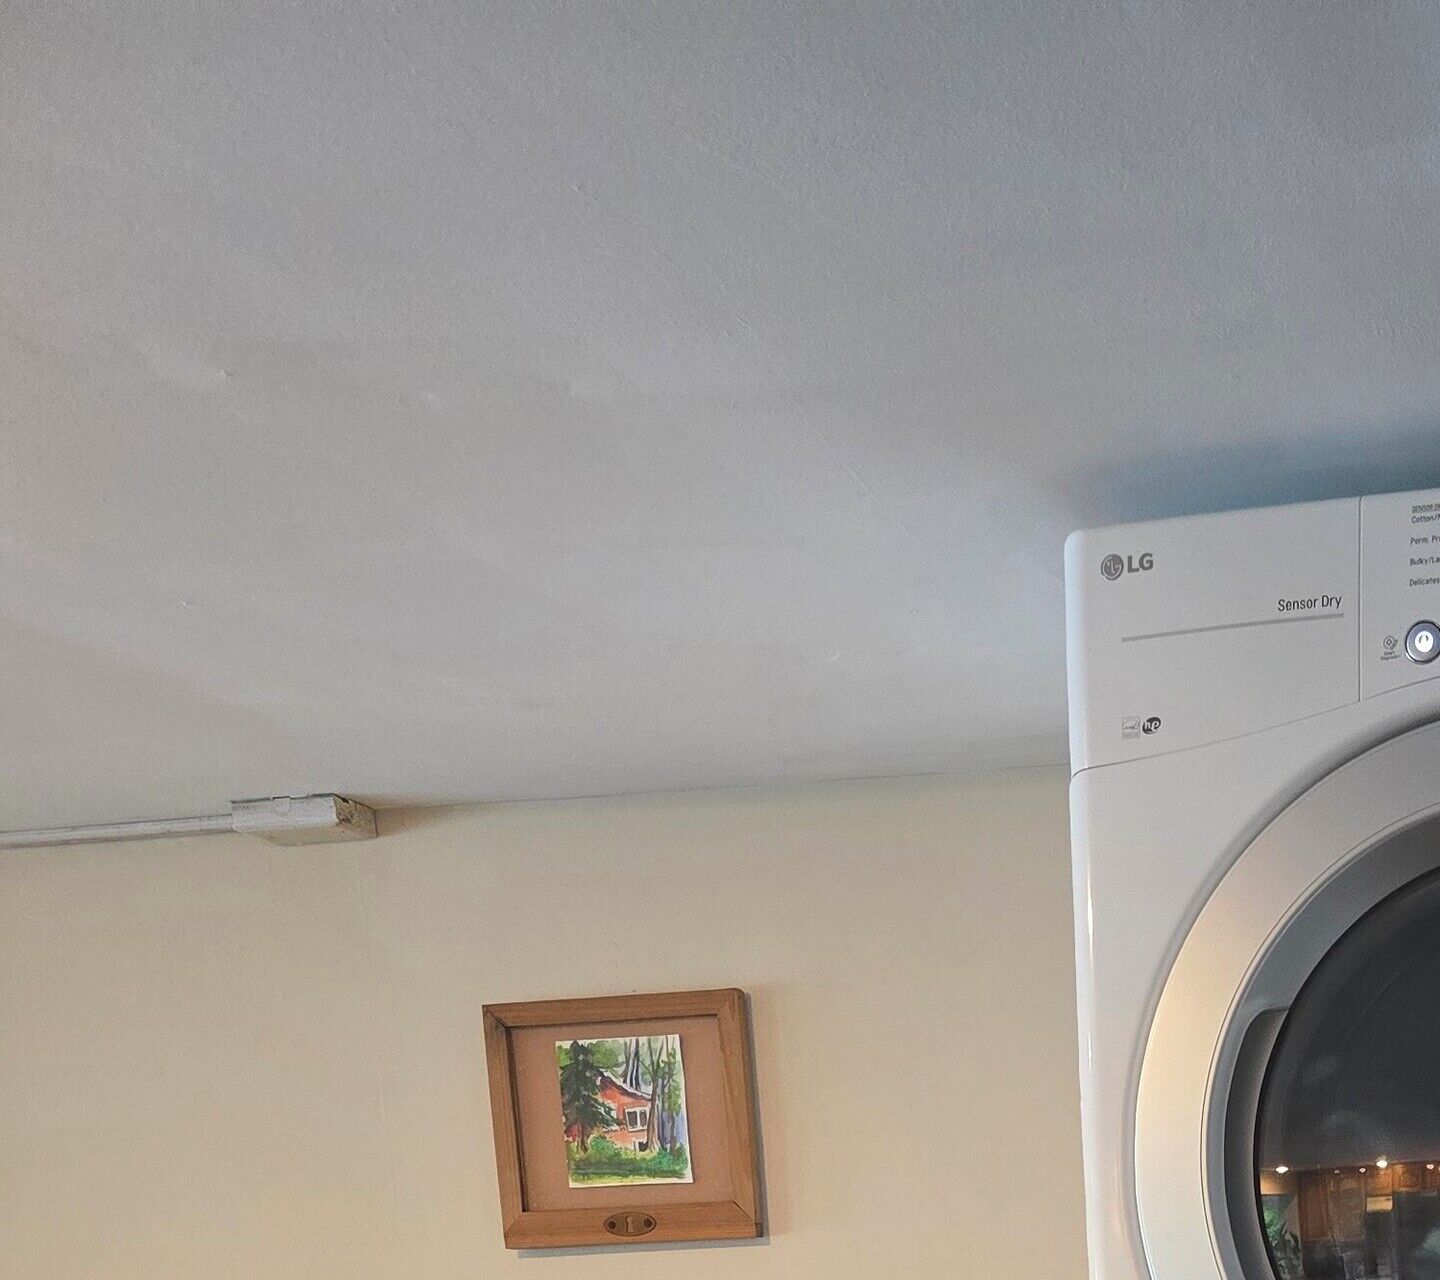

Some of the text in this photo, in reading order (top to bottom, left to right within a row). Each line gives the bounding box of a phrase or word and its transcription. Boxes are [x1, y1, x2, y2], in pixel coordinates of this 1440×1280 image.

[1127, 553, 1154, 573] LG
[1409, 578, 1440, 586] Delicates
[1278, 595, 1342, 612] Sensor Dry
